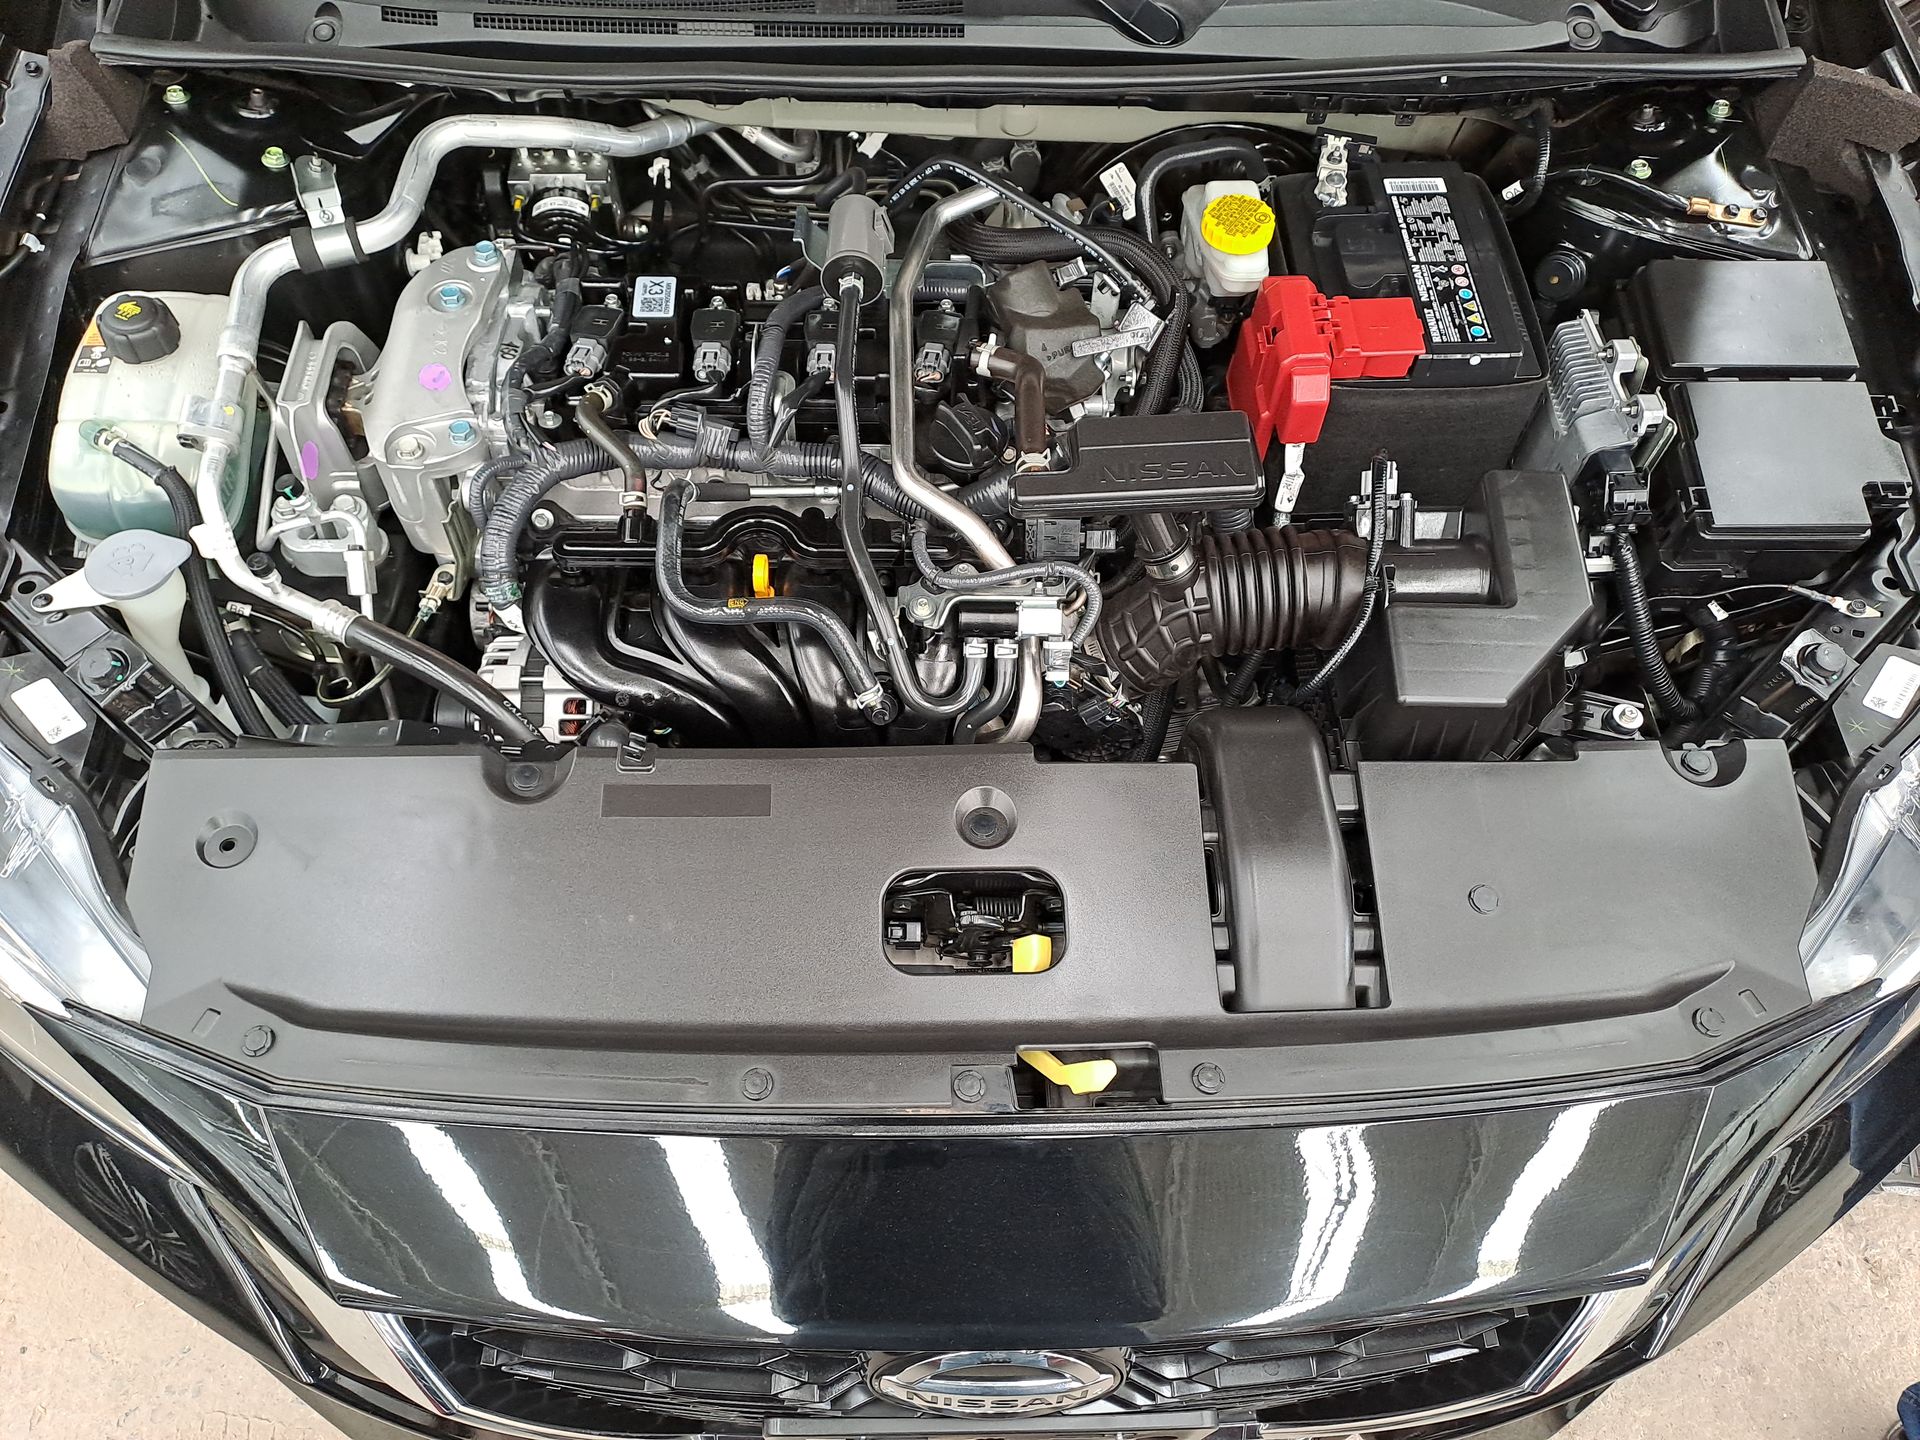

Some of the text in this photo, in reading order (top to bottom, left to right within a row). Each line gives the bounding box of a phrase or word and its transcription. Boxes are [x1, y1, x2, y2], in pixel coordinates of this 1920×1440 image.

[648, 279, 665, 296] X3
[1411, 264, 1430, 302] NISSAN
[1423, 307, 1442, 343] RENAULT
[1099, 460, 1247, 484] NISSAN
[905, 1389, 1090, 1409] NISSAN
